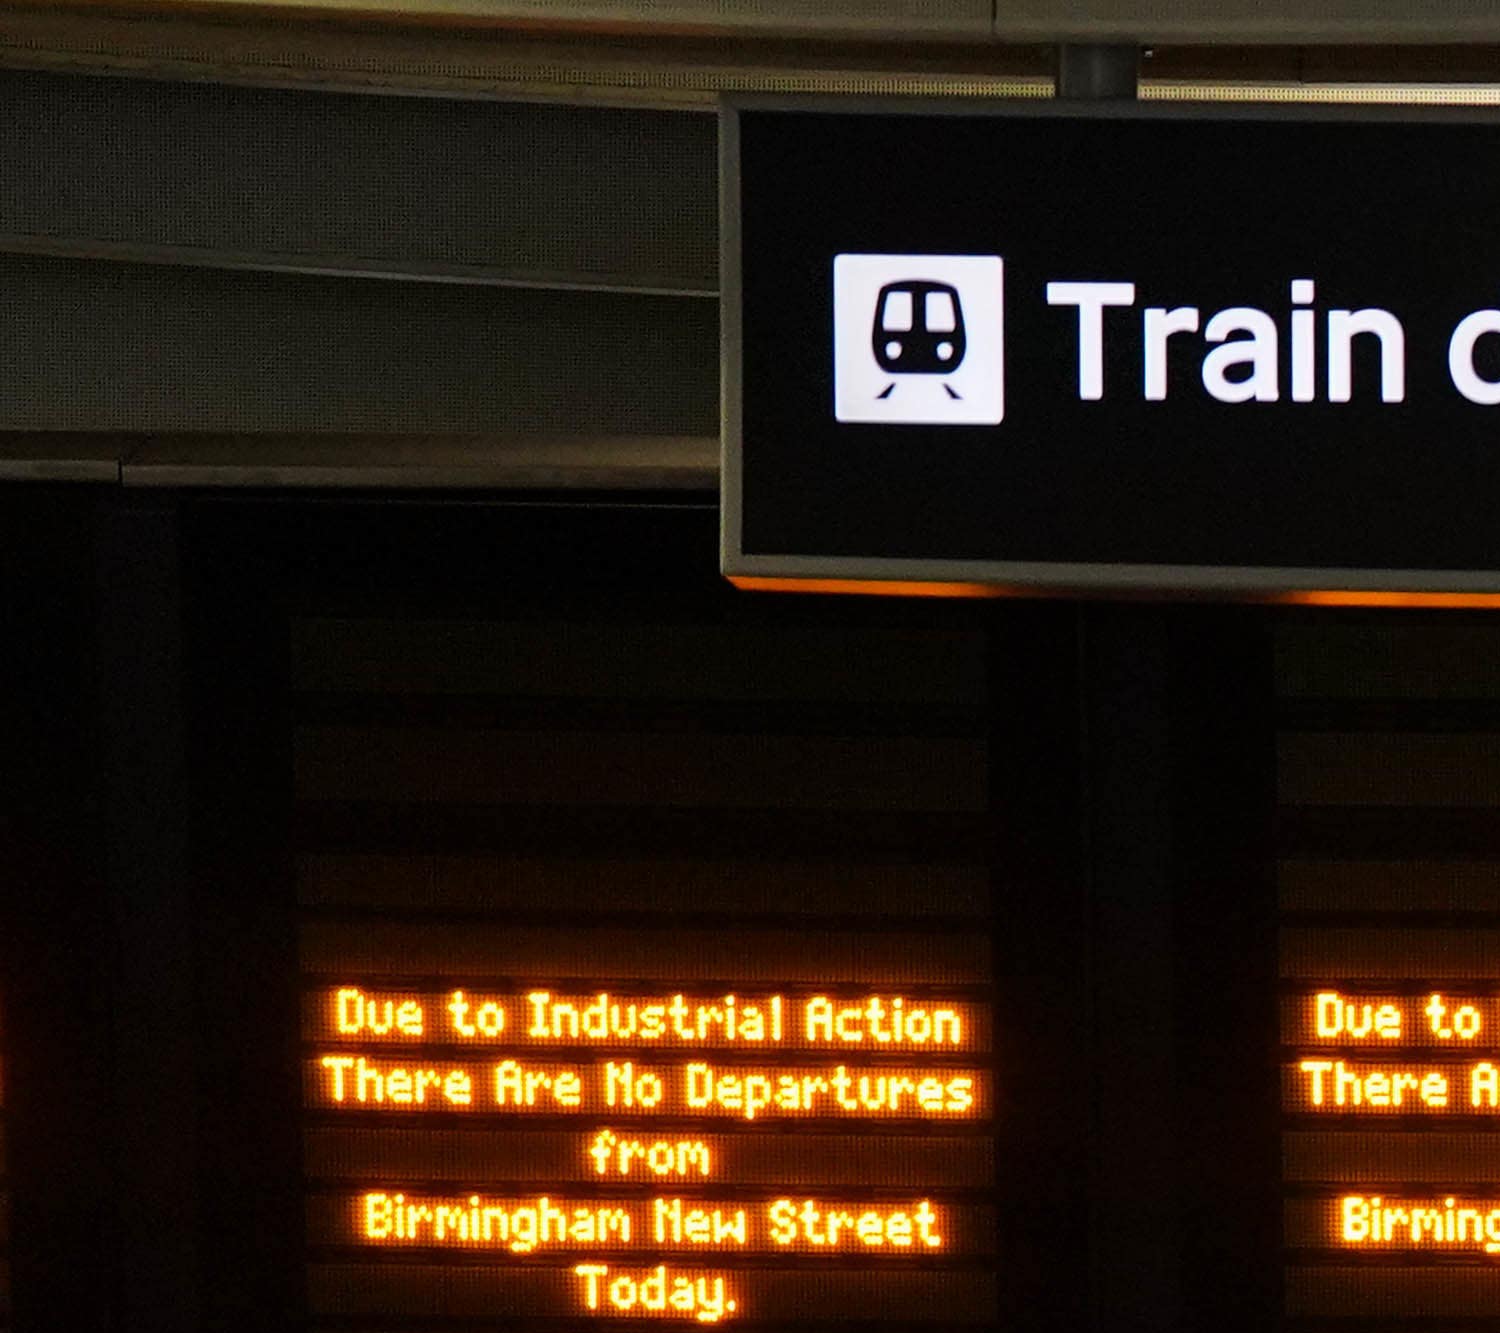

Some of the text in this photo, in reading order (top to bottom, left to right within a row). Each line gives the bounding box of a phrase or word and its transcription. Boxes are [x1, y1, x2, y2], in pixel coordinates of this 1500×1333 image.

[1046, 279, 1404, 402] Train
[335, 989, 963, 1045] Due to Industrial Action
[1314, 993, 1403, 1039] Due
[1424, 994, 1482, 1040] to
[321, 1056, 973, 1119] There Are No Departures
[1299, 1061, 1448, 1107] There
[588, 1130, 710, 1176] from
[363, 1193, 941, 1252] Birmingham New Street
[572, 1264, 736, 1322] Today.
